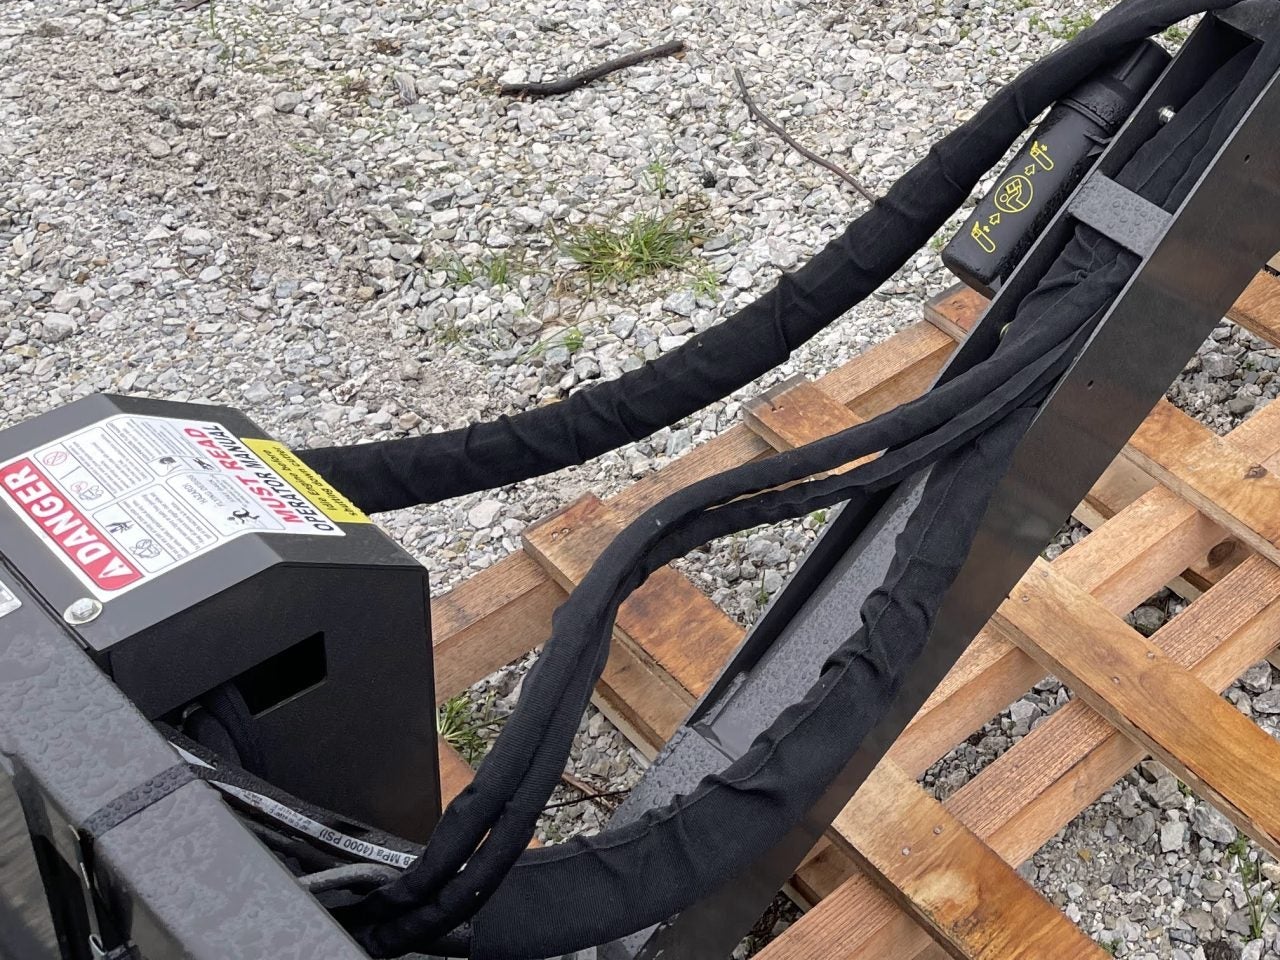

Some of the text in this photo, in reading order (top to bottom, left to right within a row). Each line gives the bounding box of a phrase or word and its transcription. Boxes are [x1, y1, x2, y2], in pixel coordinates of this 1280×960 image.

[184, 428, 246, 471] READ
[202, 425, 267, 469] MANUAL
[236, 474, 304, 524] MUST
[254, 472, 335, 532] OPERATOR
[263, 449, 337, 511] Idle Engine before
[272, 446, 359, 516] shutting down cutter
[4, 464, 113, 565] DANGER
[319, 828, 342, 845] PSI)
[344, 840, 374, 857] (4000
[376, 848, 401, 865] MPa
